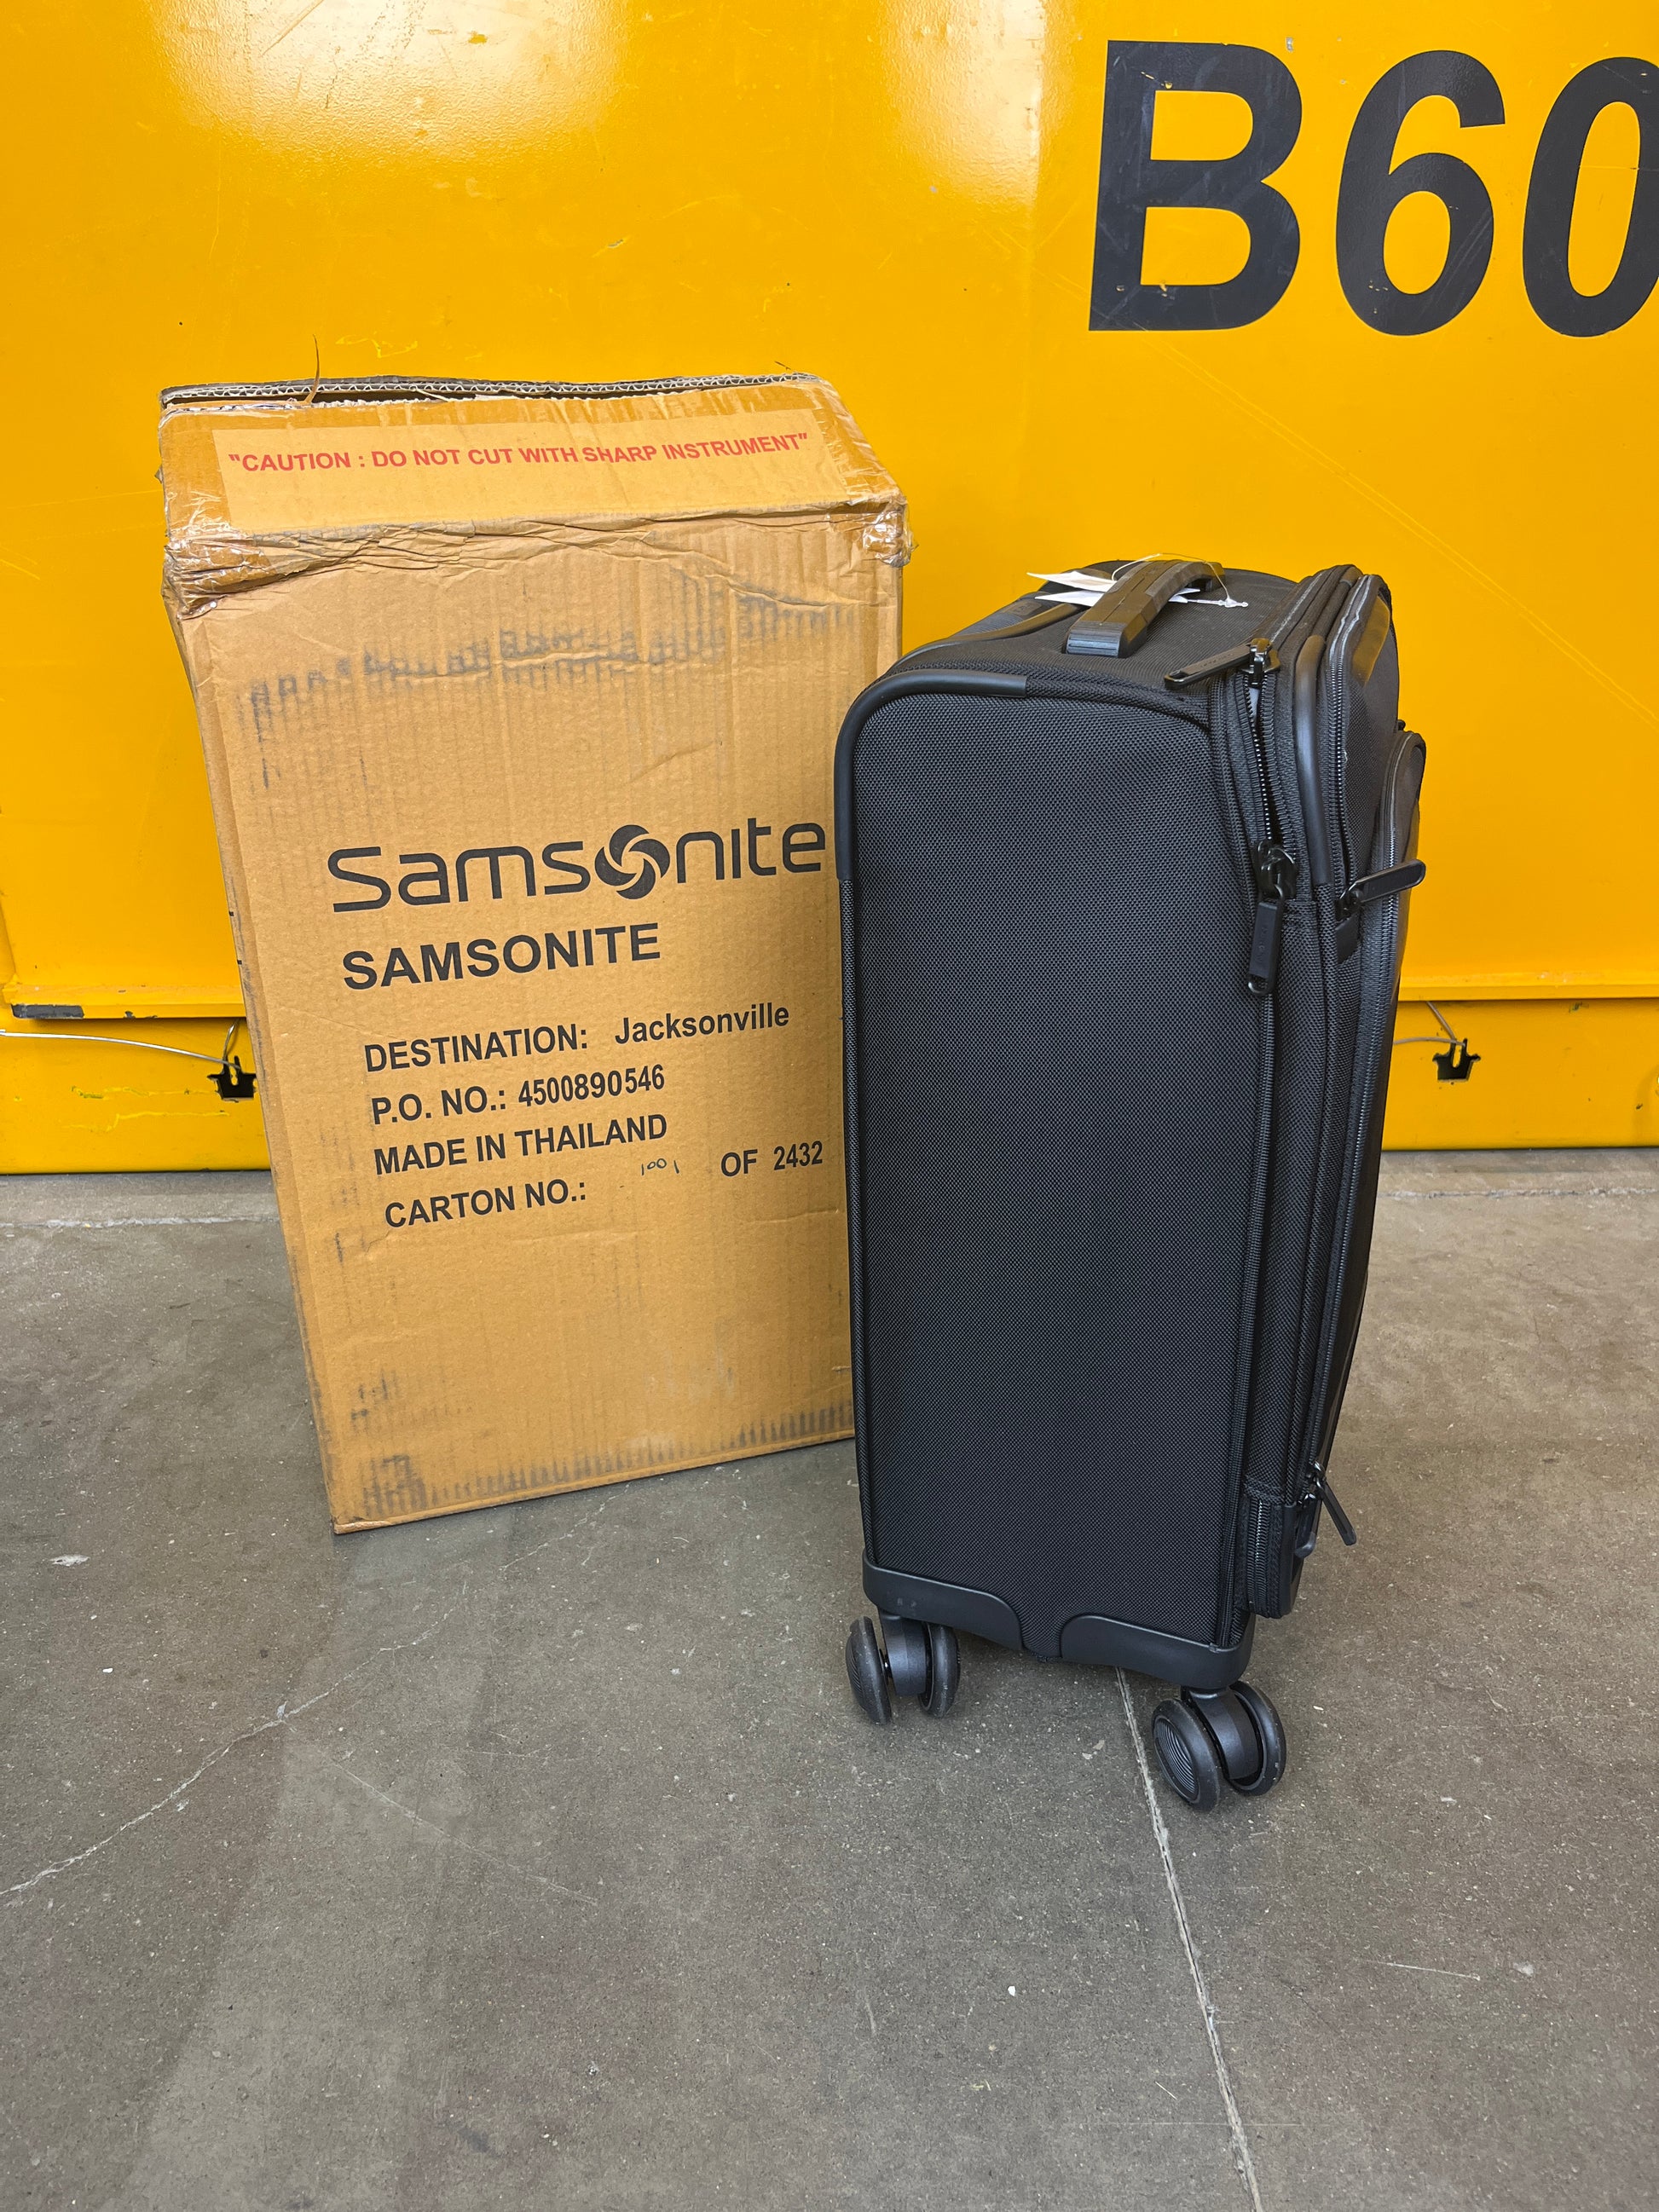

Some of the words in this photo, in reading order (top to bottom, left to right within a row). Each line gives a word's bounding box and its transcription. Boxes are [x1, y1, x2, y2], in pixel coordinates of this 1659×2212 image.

[1089, 40, 1659, 338] B60
[228, 451, 351, 471] "CAUTION
[372, 450, 408, 467] DO
[413, 448, 460, 466] NOT
[468, 448, 512, 465] CUT
[518, 447, 579, 463] WITH
[582, 444, 657, 464] SHARP
[662, 432, 808, 460] INSTRUMENT"
[327, 817, 826, 912] Samsonite
[343, 922, 661, 990] SAMSONITE
[364, 1023, 587, 1072] DESTINATION:
[615, 1002, 789, 1044] Jacksonville
[372, 1094, 432, 1125] P.O.
[442, 1086, 506, 1117] NO.:
[518, 1064, 665, 1107] 4500890546
[374, 1138, 467, 1175] MADE
[477, 1134, 506, 1162] IN
[514, 1114, 667, 1157] THAILAND
[384, 1187, 516, 1227] CARTON
[524, 1179, 586, 1209] NO.:
[720, 1148, 759, 1177] OF
[773, 1140, 824, 1171] 2432
